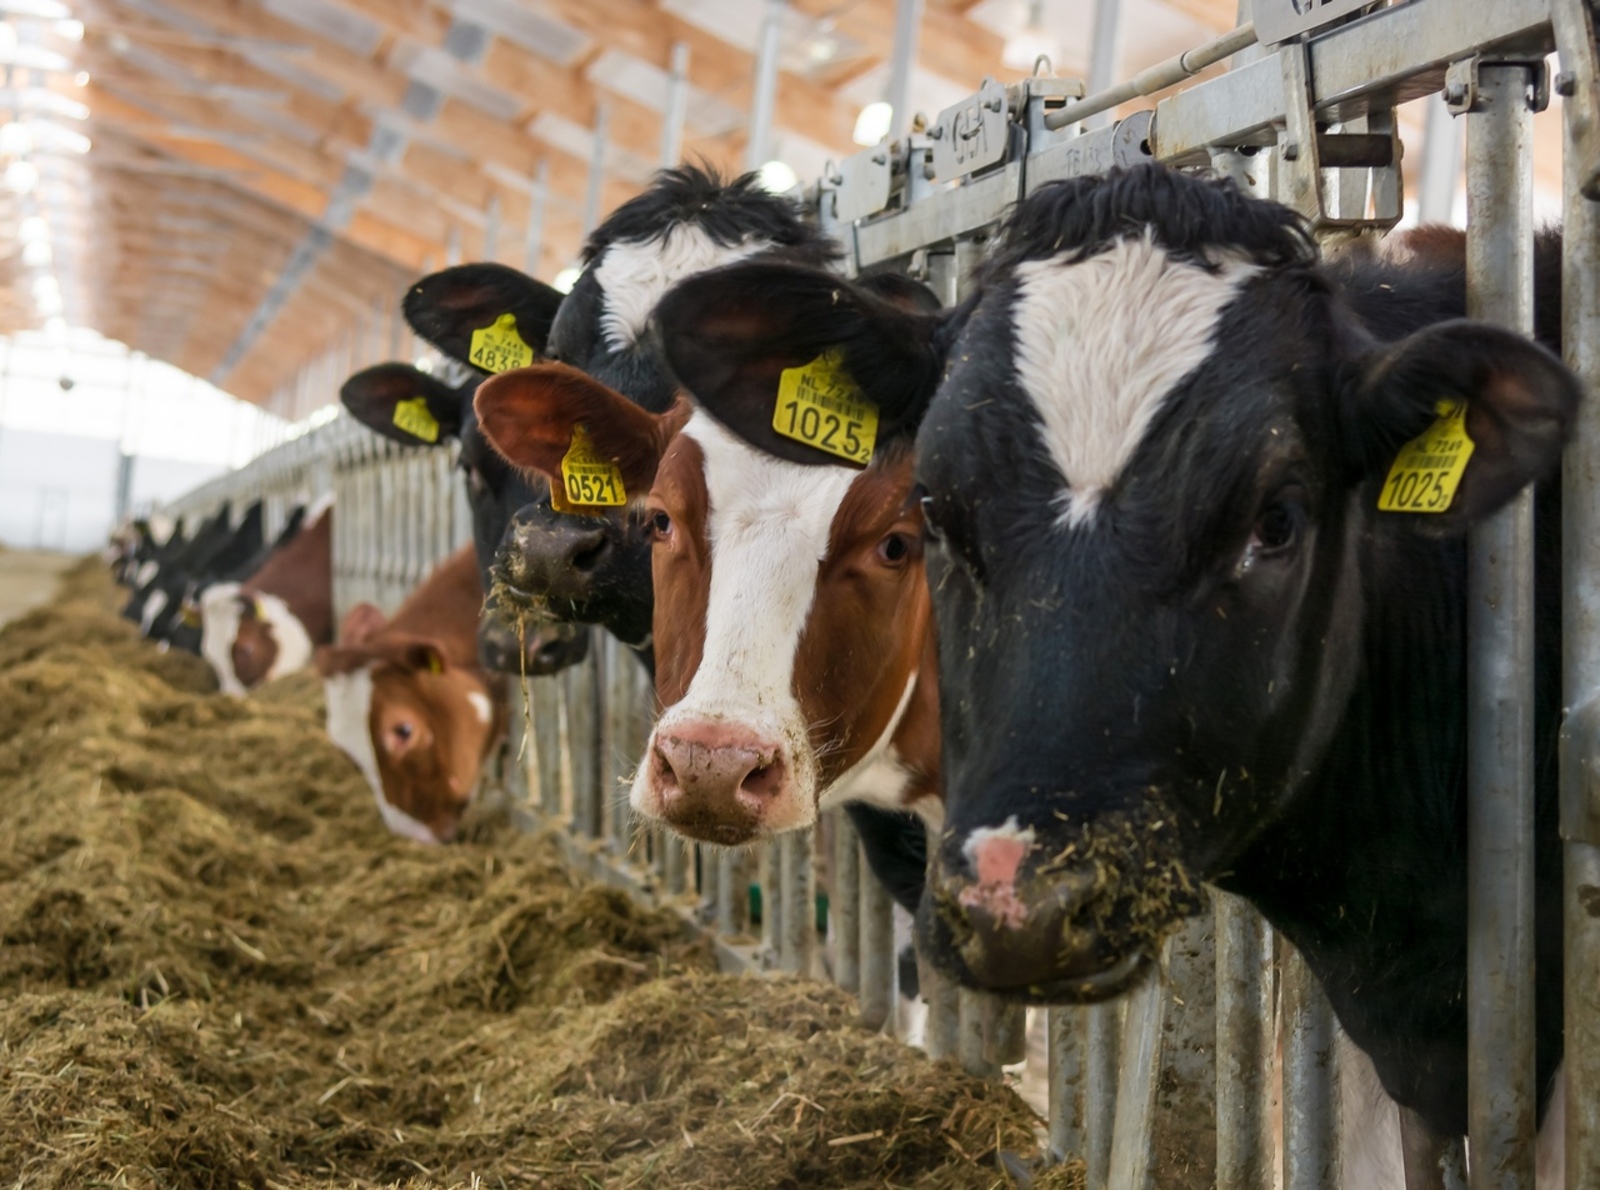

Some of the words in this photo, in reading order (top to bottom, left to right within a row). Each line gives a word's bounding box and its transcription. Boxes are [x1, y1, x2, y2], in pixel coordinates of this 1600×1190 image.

[801, 373, 819, 391] NL
[785, 400, 863, 456] 1025
[567, 473, 619, 503] 0521
[1386, 470, 1450, 508] 1025
